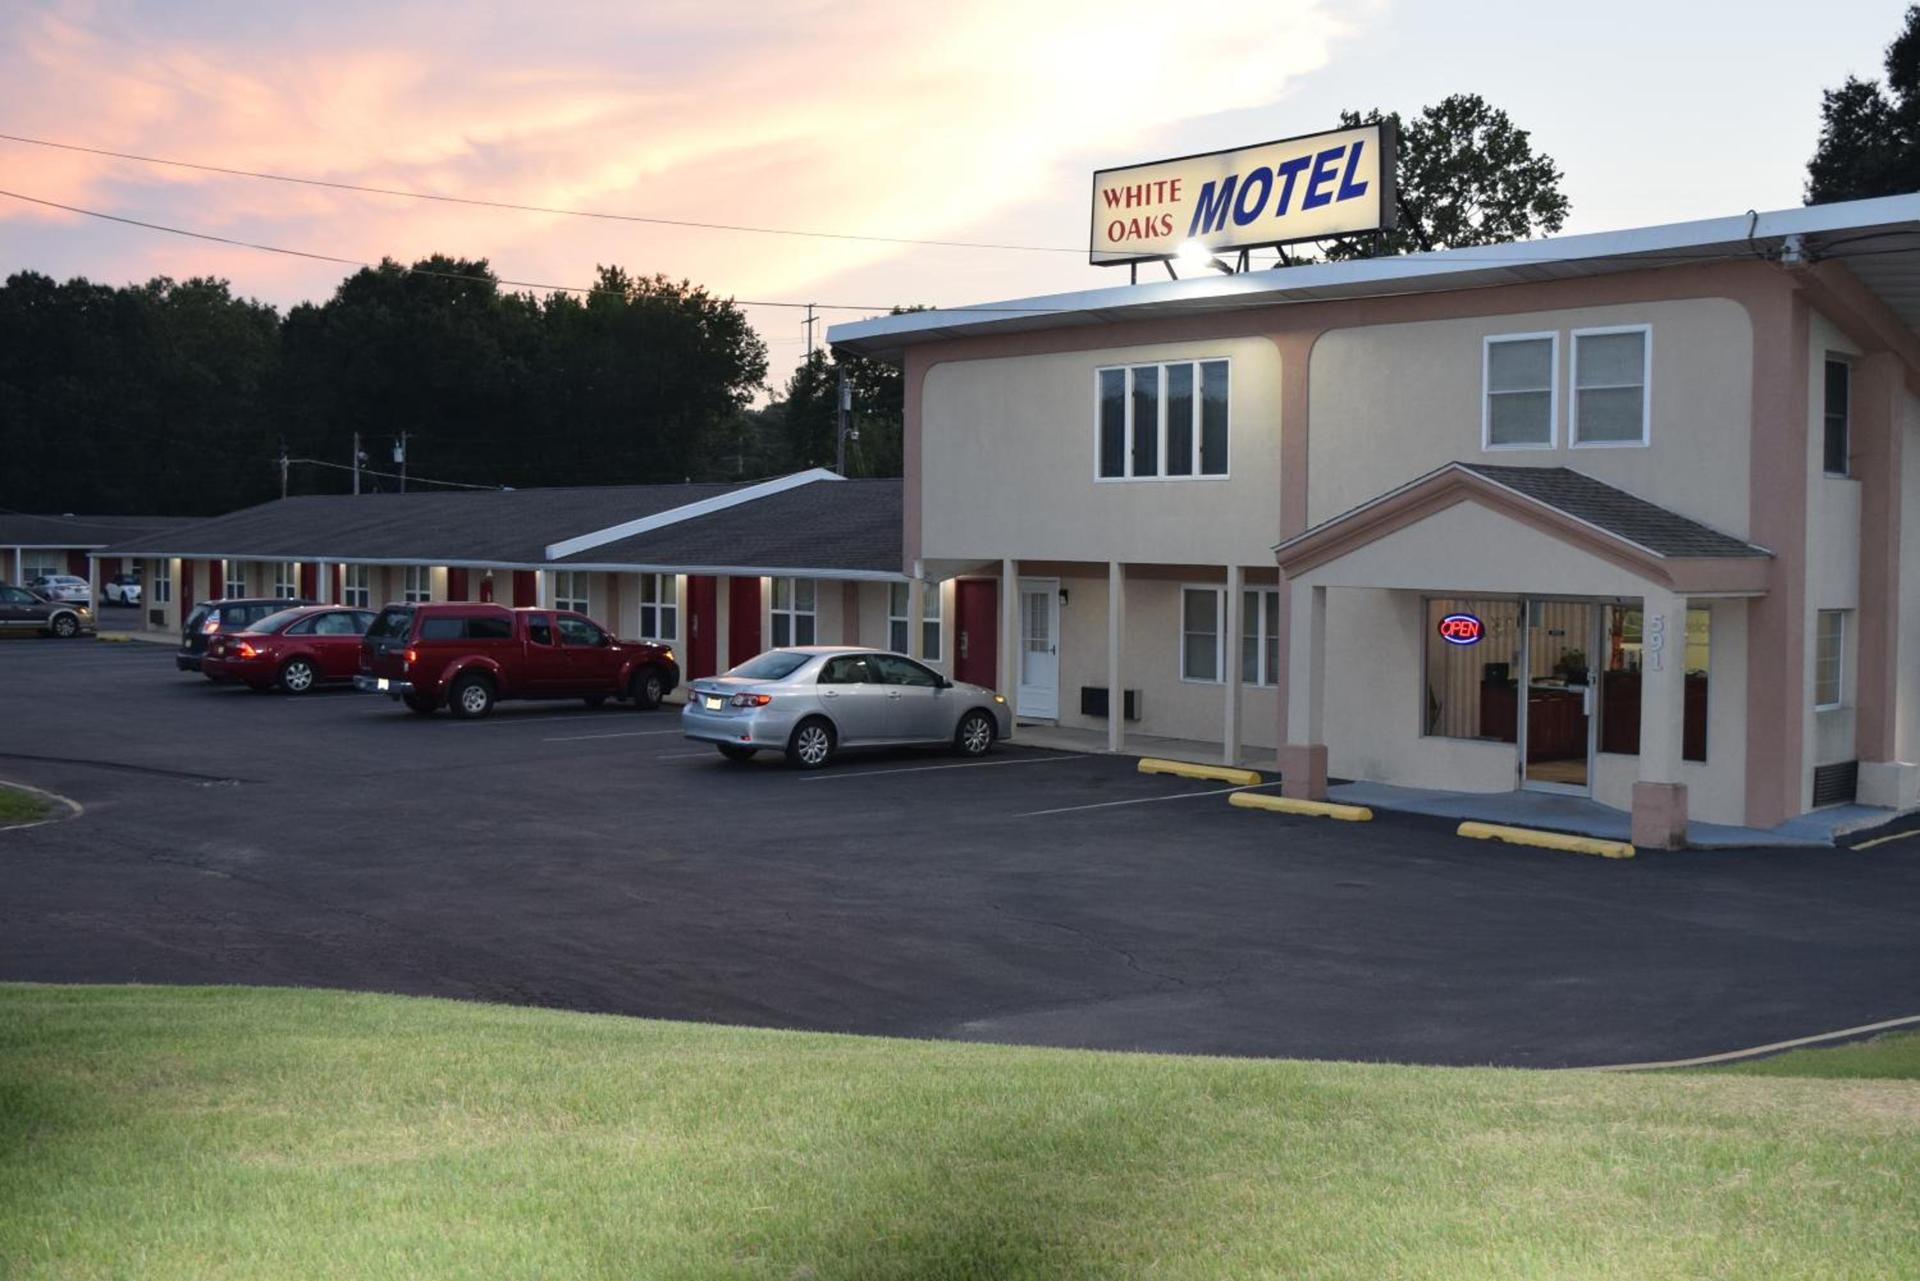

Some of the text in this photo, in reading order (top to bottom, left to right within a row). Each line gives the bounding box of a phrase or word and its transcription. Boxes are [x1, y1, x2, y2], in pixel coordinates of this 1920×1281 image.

[1102, 178, 1182, 209] WHITE
[1187, 140, 1369, 237] MOTEL
[1107, 213, 1173, 242] OAKS
[1440, 620, 1480, 637] OPEN
[1649, 614, 1664, 671] 591
